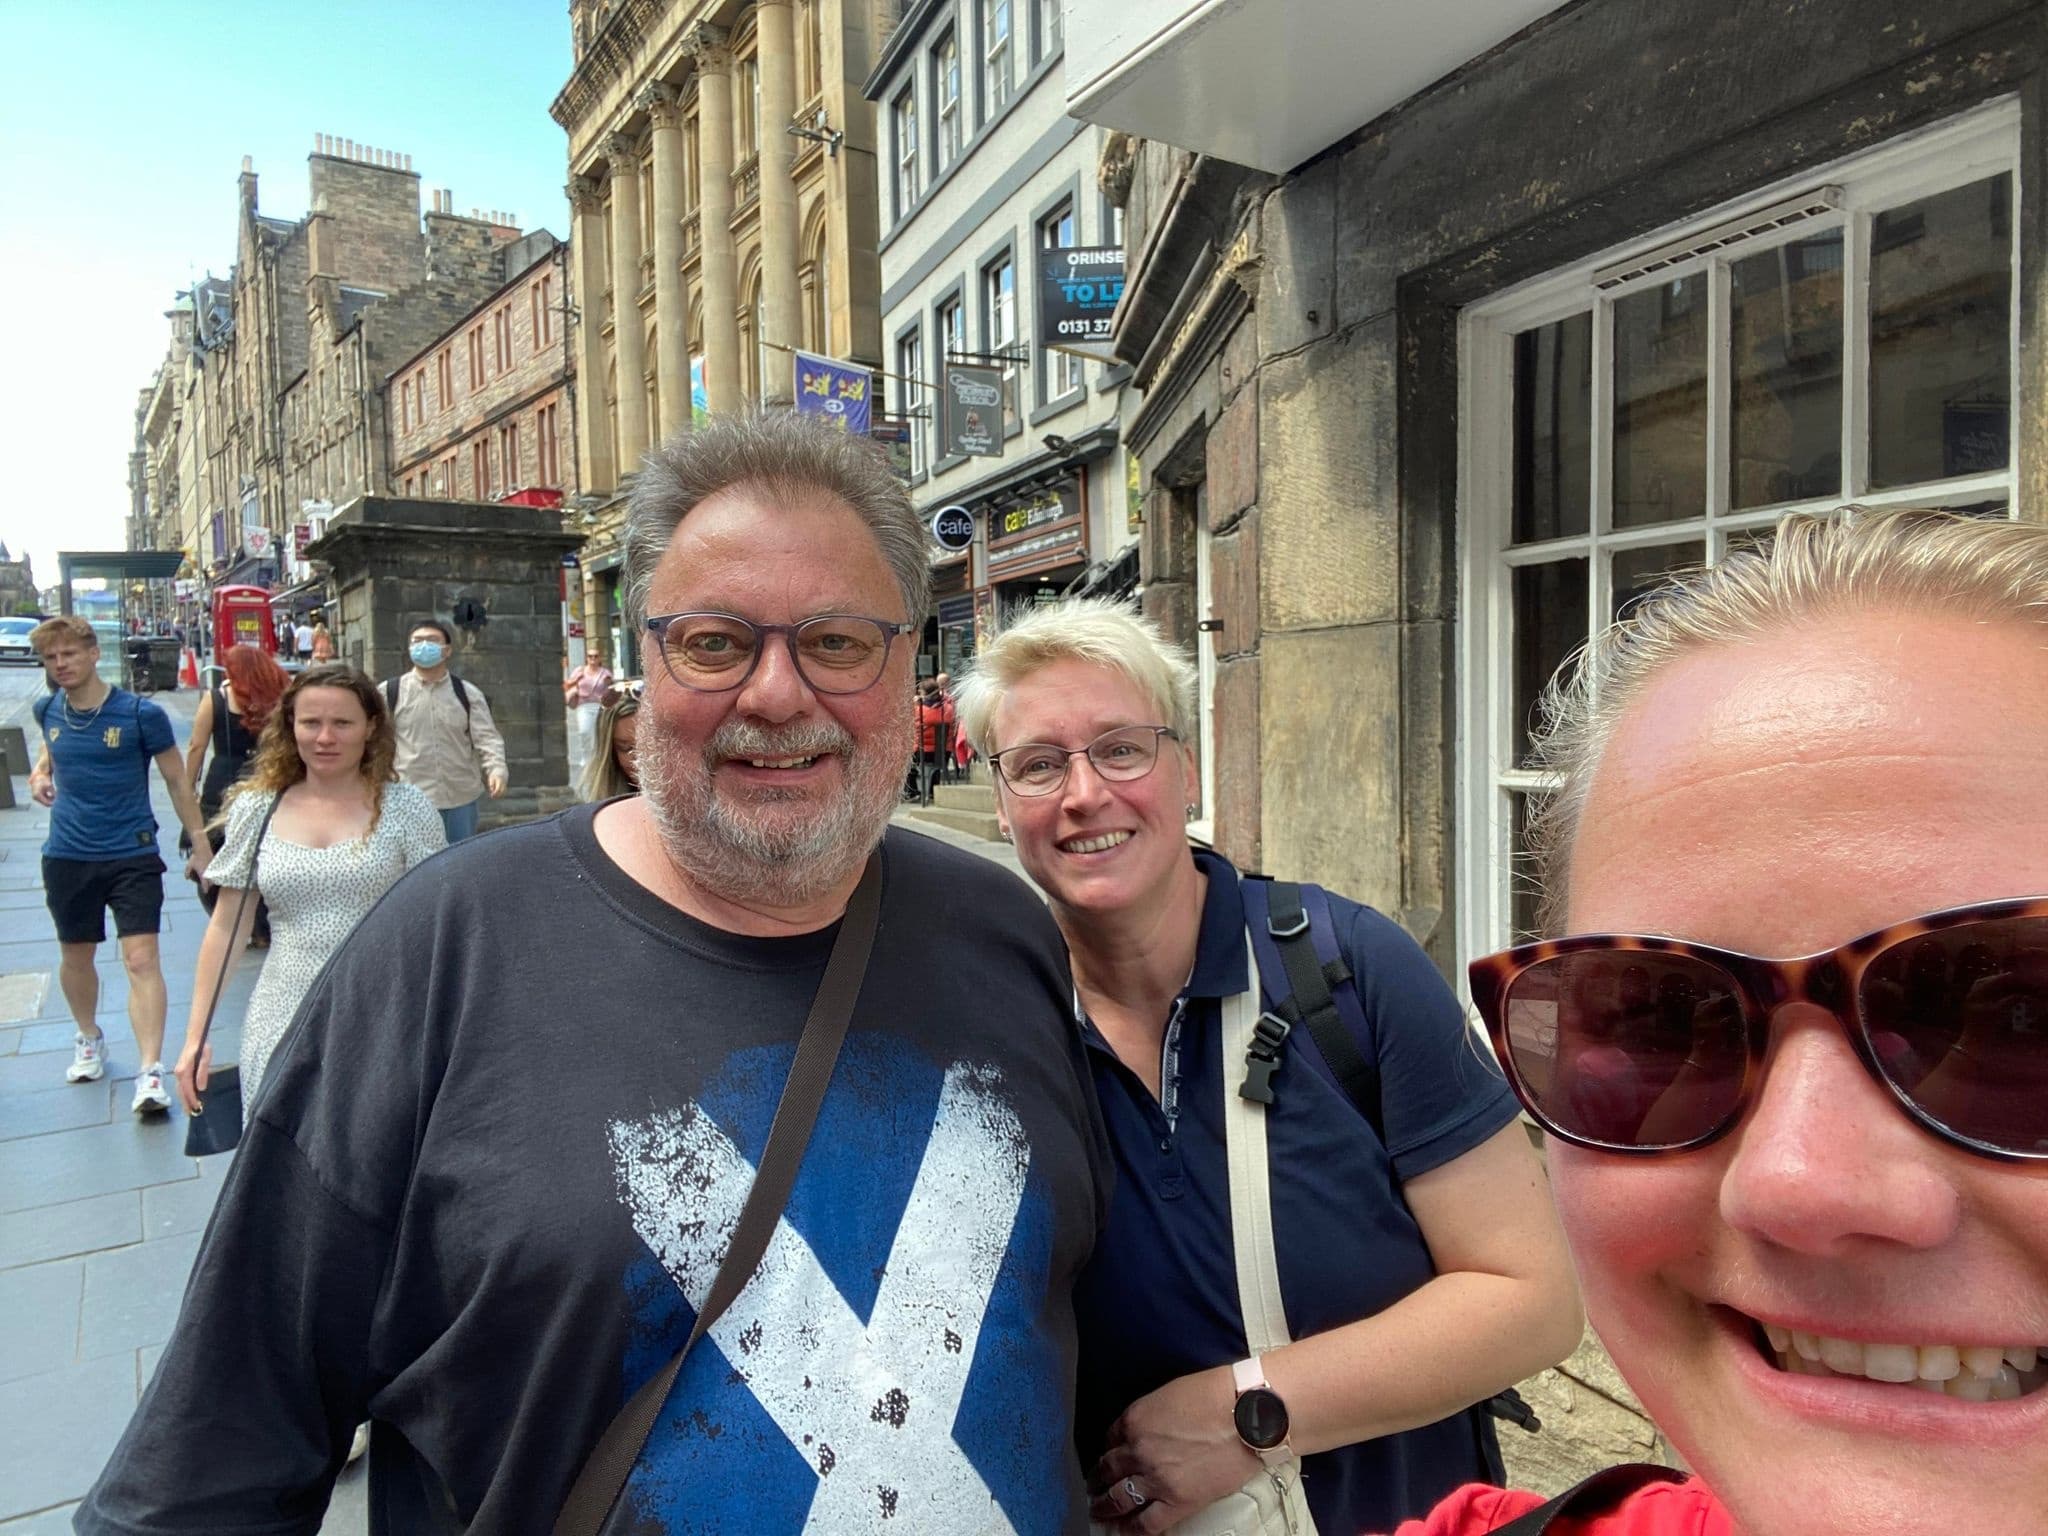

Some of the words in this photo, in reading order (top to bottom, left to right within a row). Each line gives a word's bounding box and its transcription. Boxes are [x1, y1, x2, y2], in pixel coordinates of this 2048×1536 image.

[1062, 284, 1094, 302] TO
[1058, 320, 1090, 333] 0131
[938, 518, 973, 535] cafe
